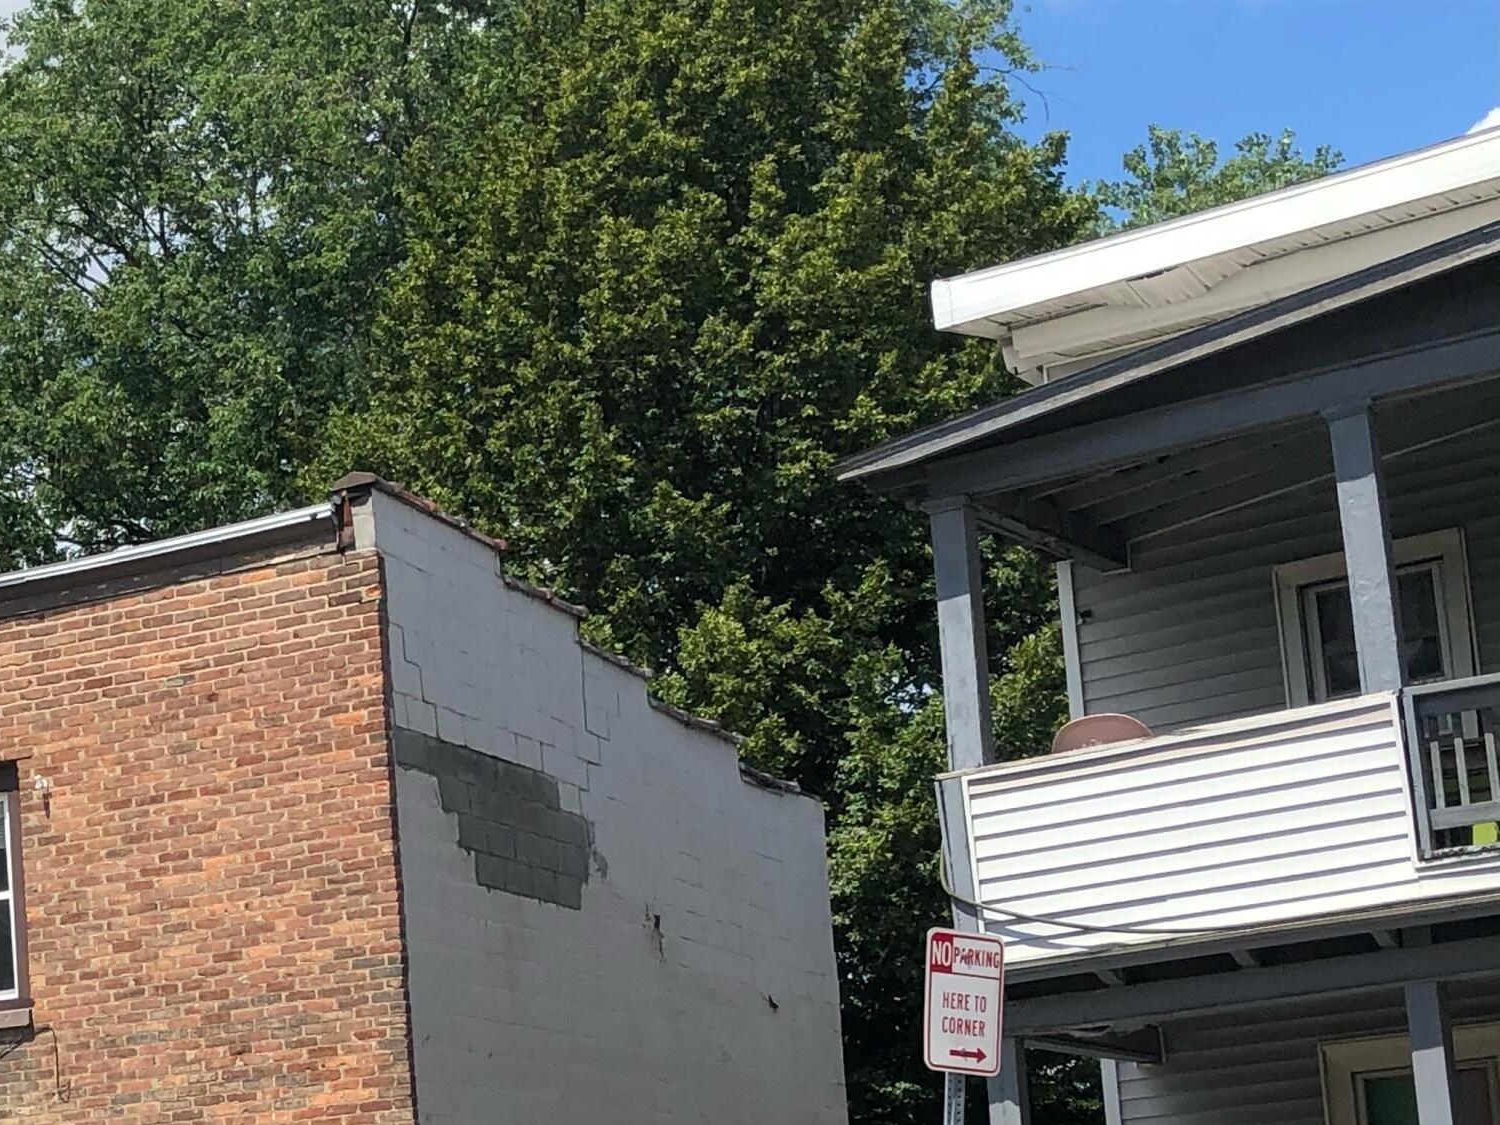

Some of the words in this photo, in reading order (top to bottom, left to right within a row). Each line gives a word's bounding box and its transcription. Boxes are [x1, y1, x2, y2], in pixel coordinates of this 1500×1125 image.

[932, 940, 950, 967] NO
[953, 946, 1000, 969] PARKING
[942, 991, 970, 1010] HERE
[975, 995, 987, 1013] TO
[942, 1016, 985, 1037] CORNER
